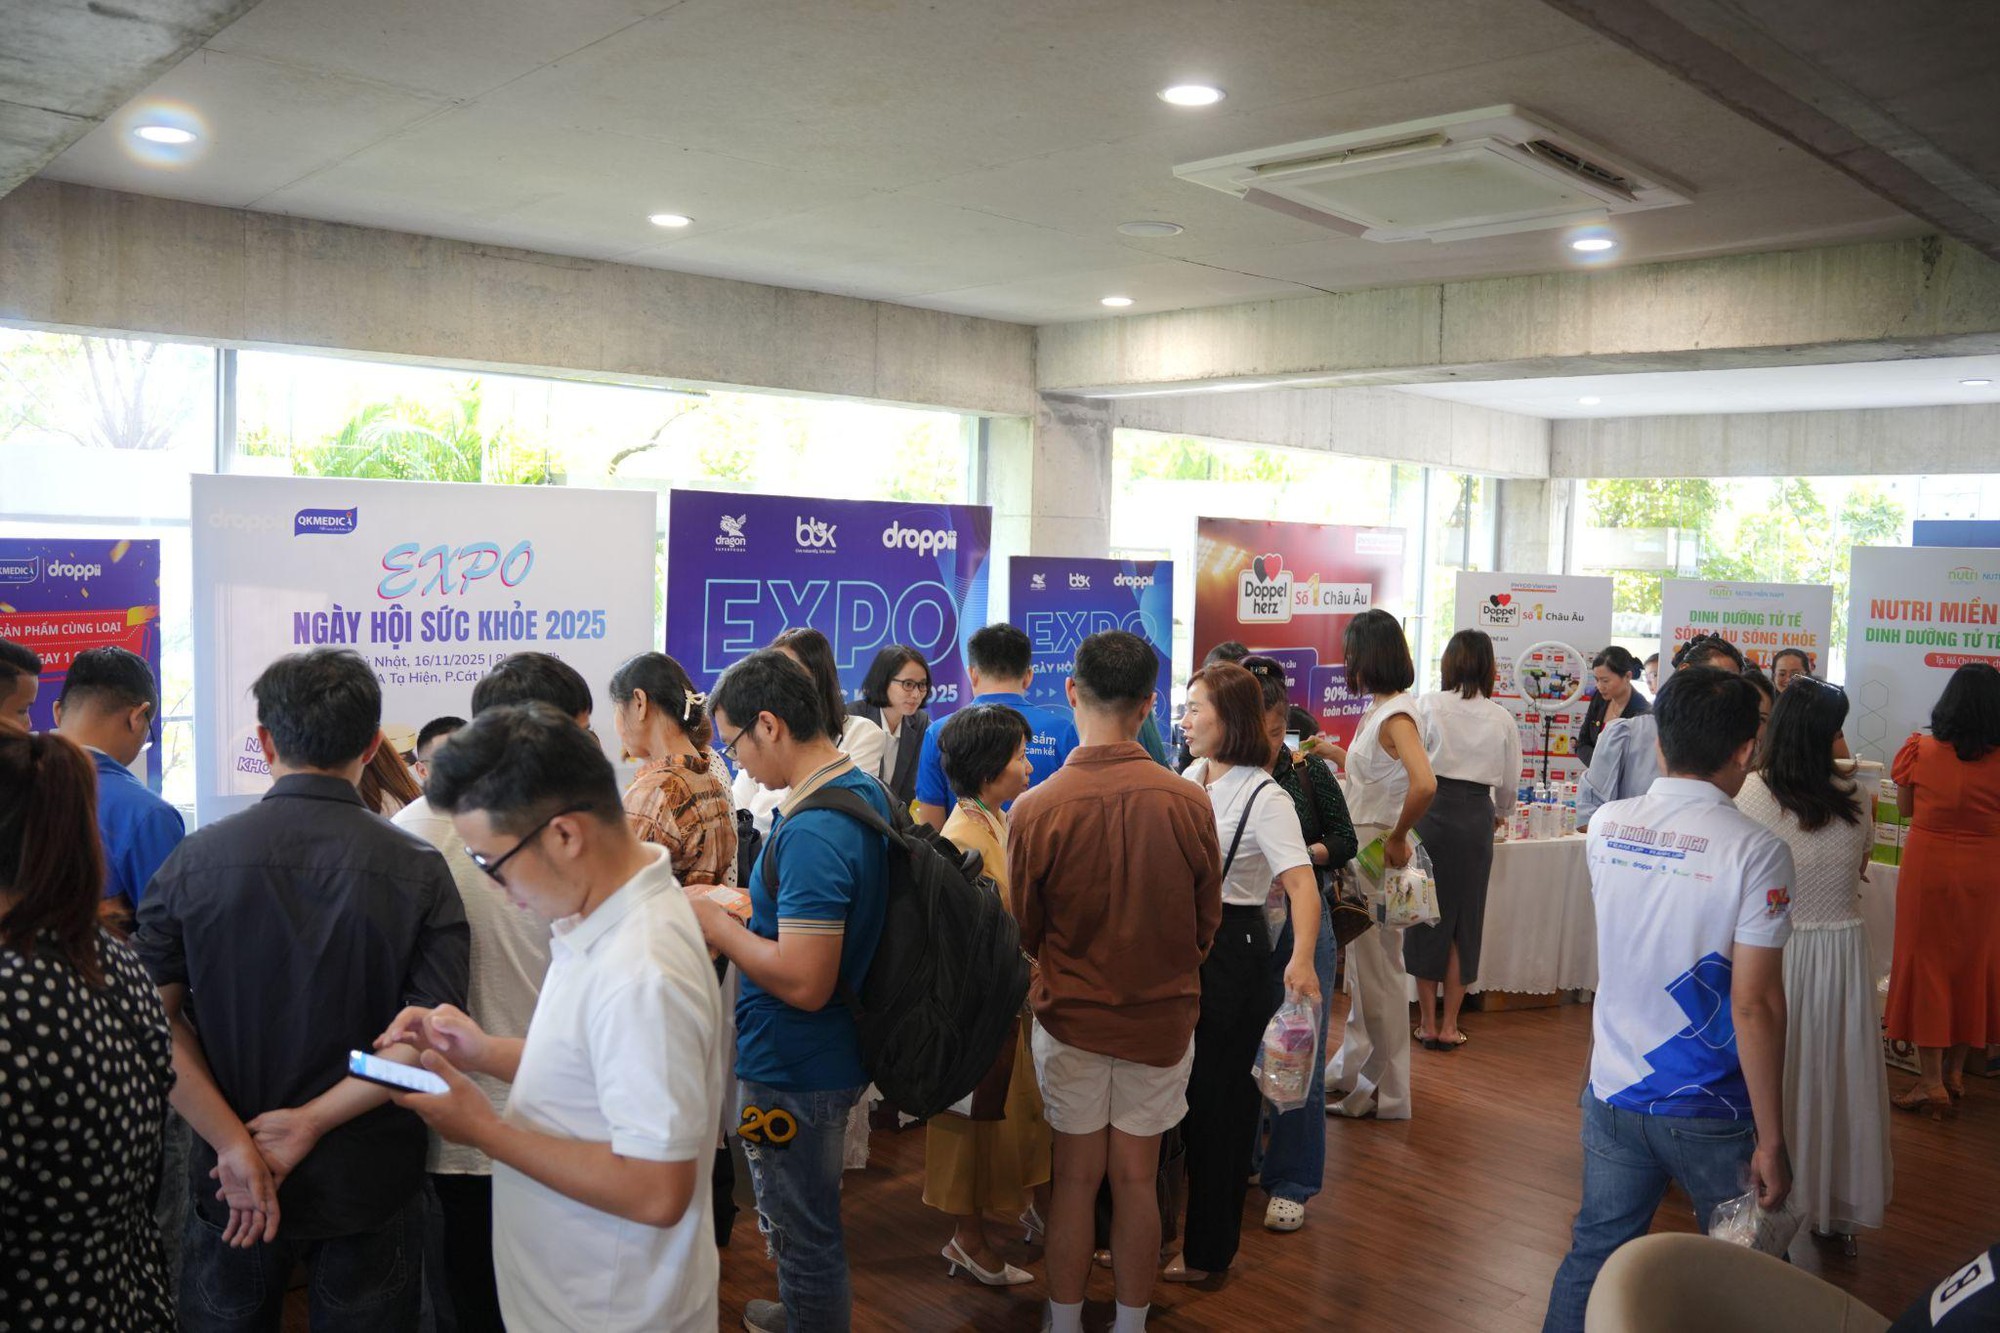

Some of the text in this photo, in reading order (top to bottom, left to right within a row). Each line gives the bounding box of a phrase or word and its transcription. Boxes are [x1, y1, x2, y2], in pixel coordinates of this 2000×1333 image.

[297, 510, 353, 527] QKMEDICA
[715, 535, 746, 549] dragon
[882, 520, 957, 557] droppii
[48, 559, 102, 581] droppii
[377, 540, 535, 600] EXPO
[1113, 573, 1154, 589] droppii
[1296, 573, 1367, 606] Số 1 Châu Âu
[1245, 581, 1287, 602] Doppel
[1253, 600, 1279, 614] herz
[1483, 606, 1516, 617] Doppel
[1533, 603, 1543, 621] 1
[1545, 612, 1569, 621] Châu
[1571, 611, 1585, 622] Âu
[1870, 596, 1998, 625] NUTRI MIỀN
[293, 600, 607, 650] NGÀY HỘI SỨC KHỎE 2025
[703, 579, 959, 673] EXPO
[1490, 614, 1510, 623] herz
[1690, 609, 1802, 627] DINH DƯỠNG TỬ TẾ
[24, 620, 59, 637] PHẨM
[61, 621, 94, 635] CÙNG
[96, 621, 122, 635] LOẠI
[1741, 626, 1778, 645] SỐNG
[1782, 630, 1816, 647] KHỎE
[1865, 627, 1901, 643] DINH
[1905, 627, 1957, 647] DƯỠNG
[1962, 628, 1983, 649] TỬ
[37, 652, 61, 665] GAY
[64, 652, 70, 663] 1
[375, 655, 410, 669] Nhật,
[415, 653, 485, 668] 16/11/2025
[1032, 660, 1054, 674] GÀY
[390, 672, 405, 686] Tạ
[409, 671, 441, 686] Hiện,
[445, 670, 478, 683] P.Cát
[1323, 685, 1348, 703] 90%
[1322, 705, 1341, 718] toàn
[1342, 703, 1361, 716] Châu
[1032, 730, 1056, 745] sắm
[737, 1104, 798, 1143] 20
